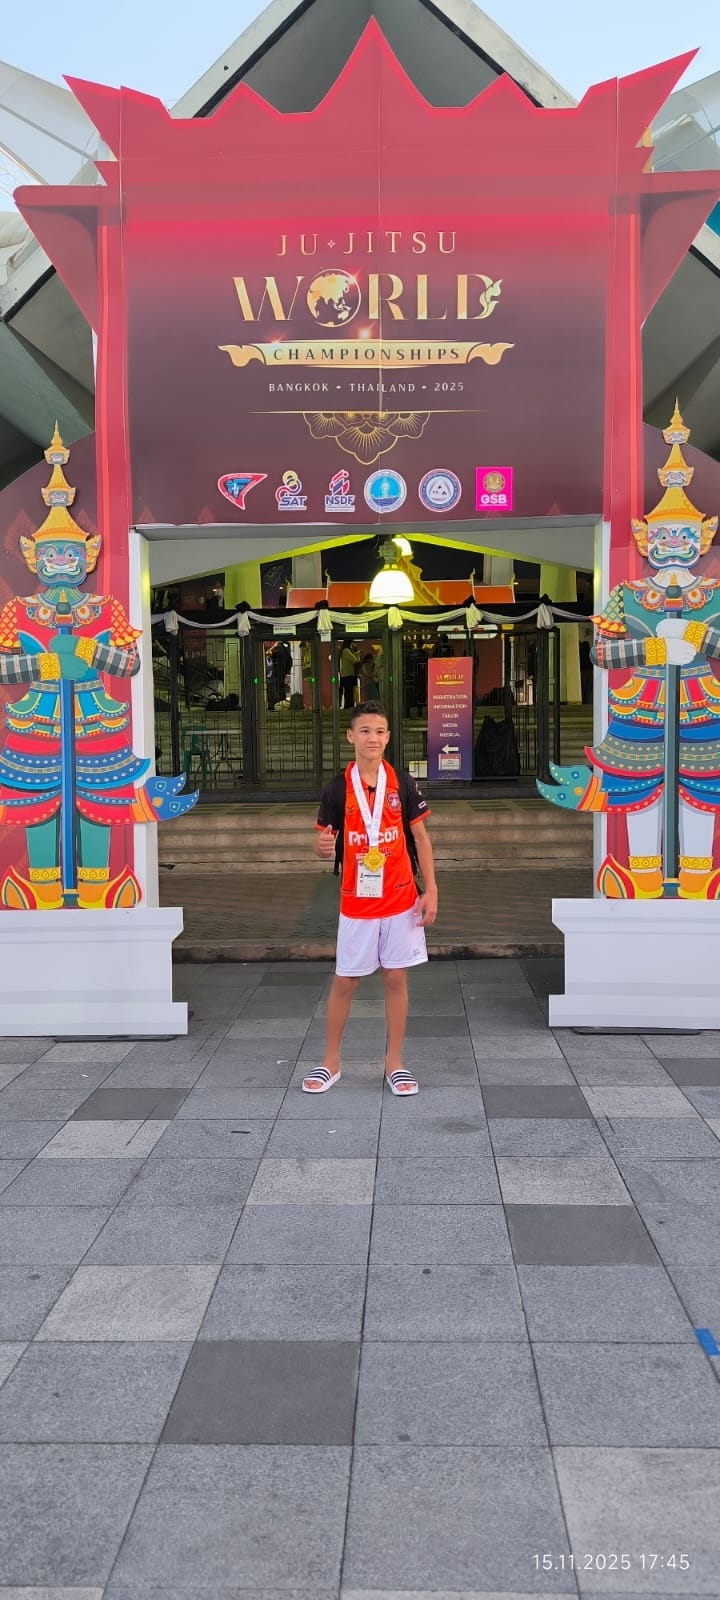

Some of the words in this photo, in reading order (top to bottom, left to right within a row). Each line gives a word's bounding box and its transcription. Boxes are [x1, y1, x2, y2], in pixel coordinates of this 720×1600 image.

[232, 268, 503, 328] WORLD
[273, 348, 460, 361] CHAMPIONSHIPS
[268, 383, 330, 393] BANGKOK
[349, 383, 416, 393] THAILAND
[433, 382, 465, 392] 2025
[280, 496, 306, 506] SAT
[325, 495, 354, 505] NSDF
[480, 494, 508, 505] GSB
[348, 830, 398, 846] Prcon
